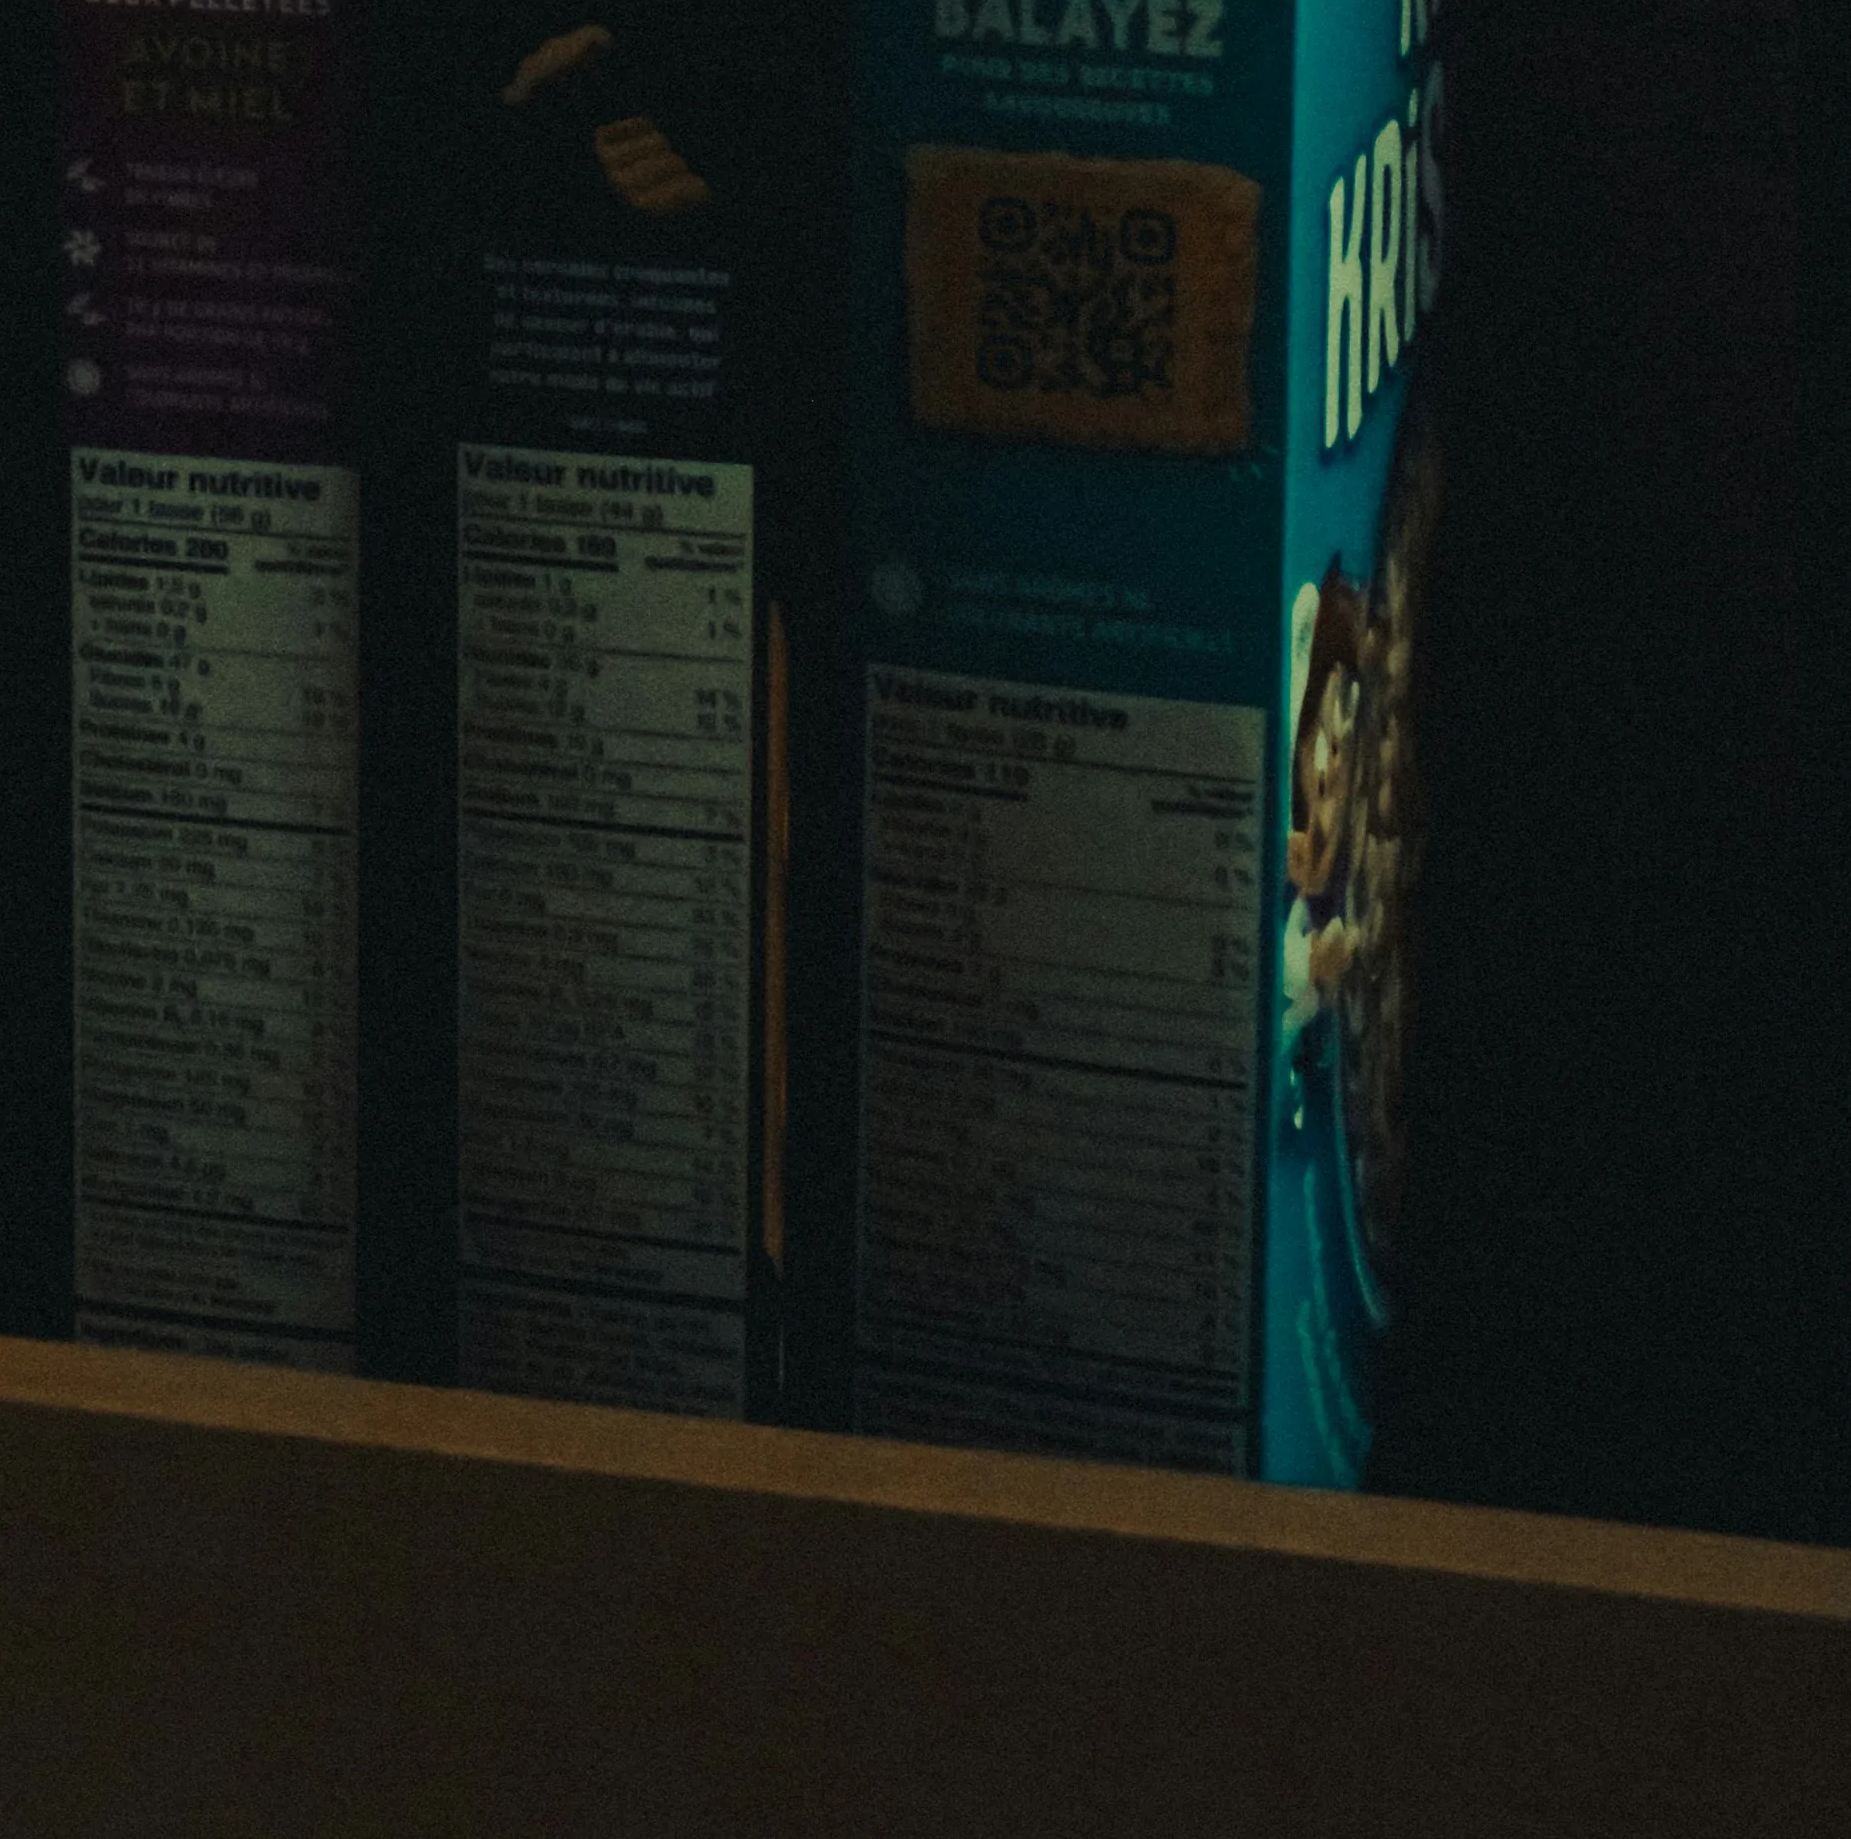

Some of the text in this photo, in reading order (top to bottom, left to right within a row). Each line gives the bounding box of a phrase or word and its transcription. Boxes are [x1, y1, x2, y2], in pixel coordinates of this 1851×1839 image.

[121, 33, 290, 74] AVOINE
[124, 80, 292, 120] ET MIEL
[79, 458, 321, 500] Valeur nutritive
[465, 451, 714, 497] Valeur nutritive
[79, 528, 177, 554] Calories
[874, 673, 1128, 731] Valeur nutritive
